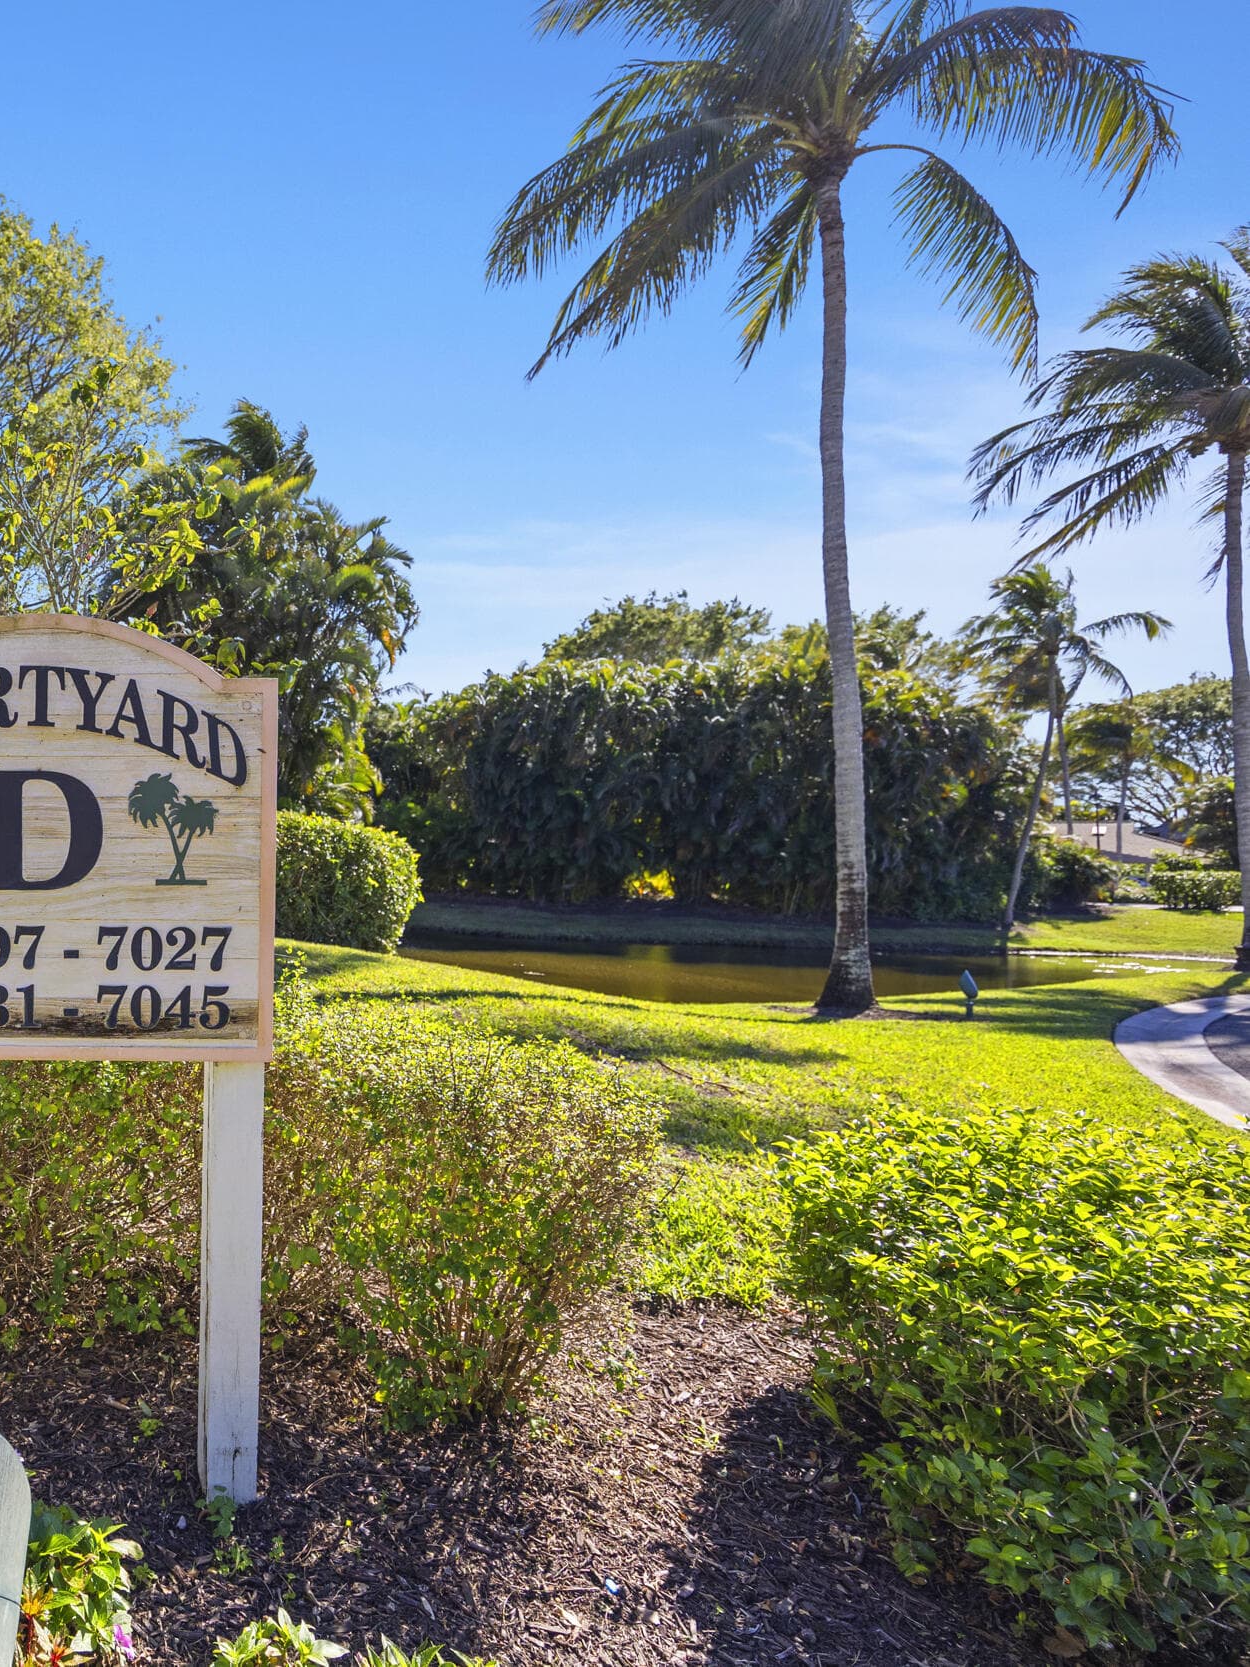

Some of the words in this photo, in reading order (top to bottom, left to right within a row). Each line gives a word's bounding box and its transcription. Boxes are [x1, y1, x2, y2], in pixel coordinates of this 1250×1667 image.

[63, 949, 79, 959] -
[97, 926, 232, 971] 7027
[63, 1007, 79, 1017] -
[97, 984, 231, 1029] 7045
